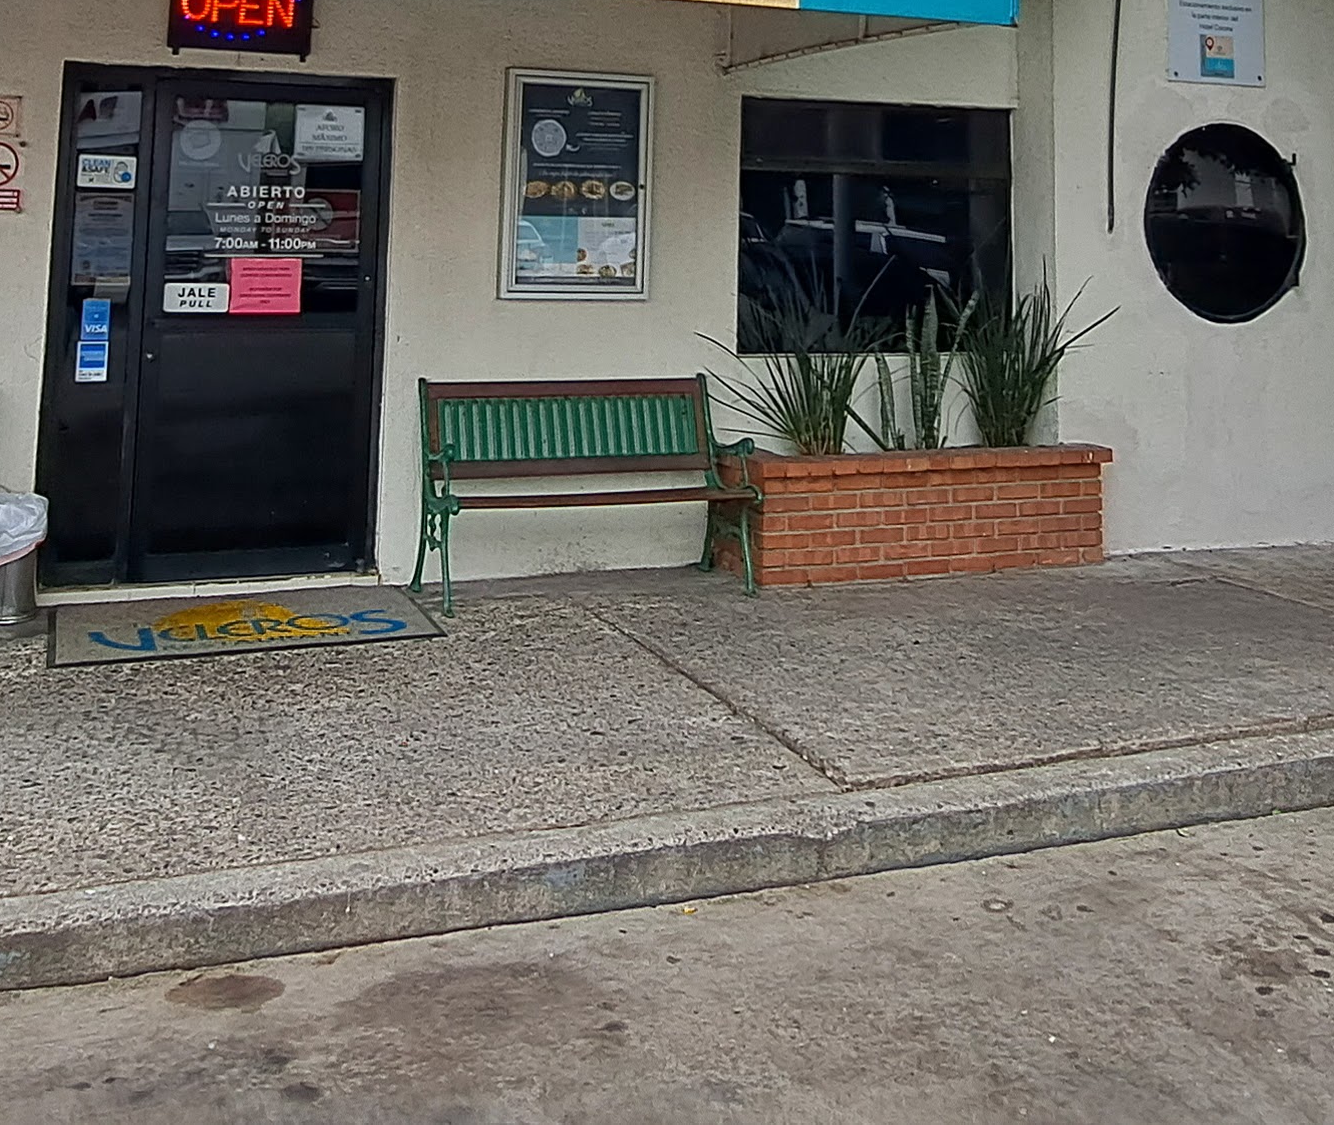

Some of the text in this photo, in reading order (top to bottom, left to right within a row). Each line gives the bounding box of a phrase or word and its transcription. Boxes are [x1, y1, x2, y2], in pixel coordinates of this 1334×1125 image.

[82, 158, 112, 167] CLEAN
[238, 152, 301, 175] VELEROS
[226, 185, 306, 199] ABIERTO
[247, 200, 285, 210] OPEN
[215, 212, 317, 226] Lunes a Domingo
[276, 226, 312, 234] SUNDAY
[214, 237, 259, 250] 7:00AM
[269, 237, 317, 250] 11:00PM
[177, 287, 217, 298] JALE
[179, 299, 213, 308] PULL
[84, 324, 108, 333] VISA
[88, 609, 408, 652] VELEROS
